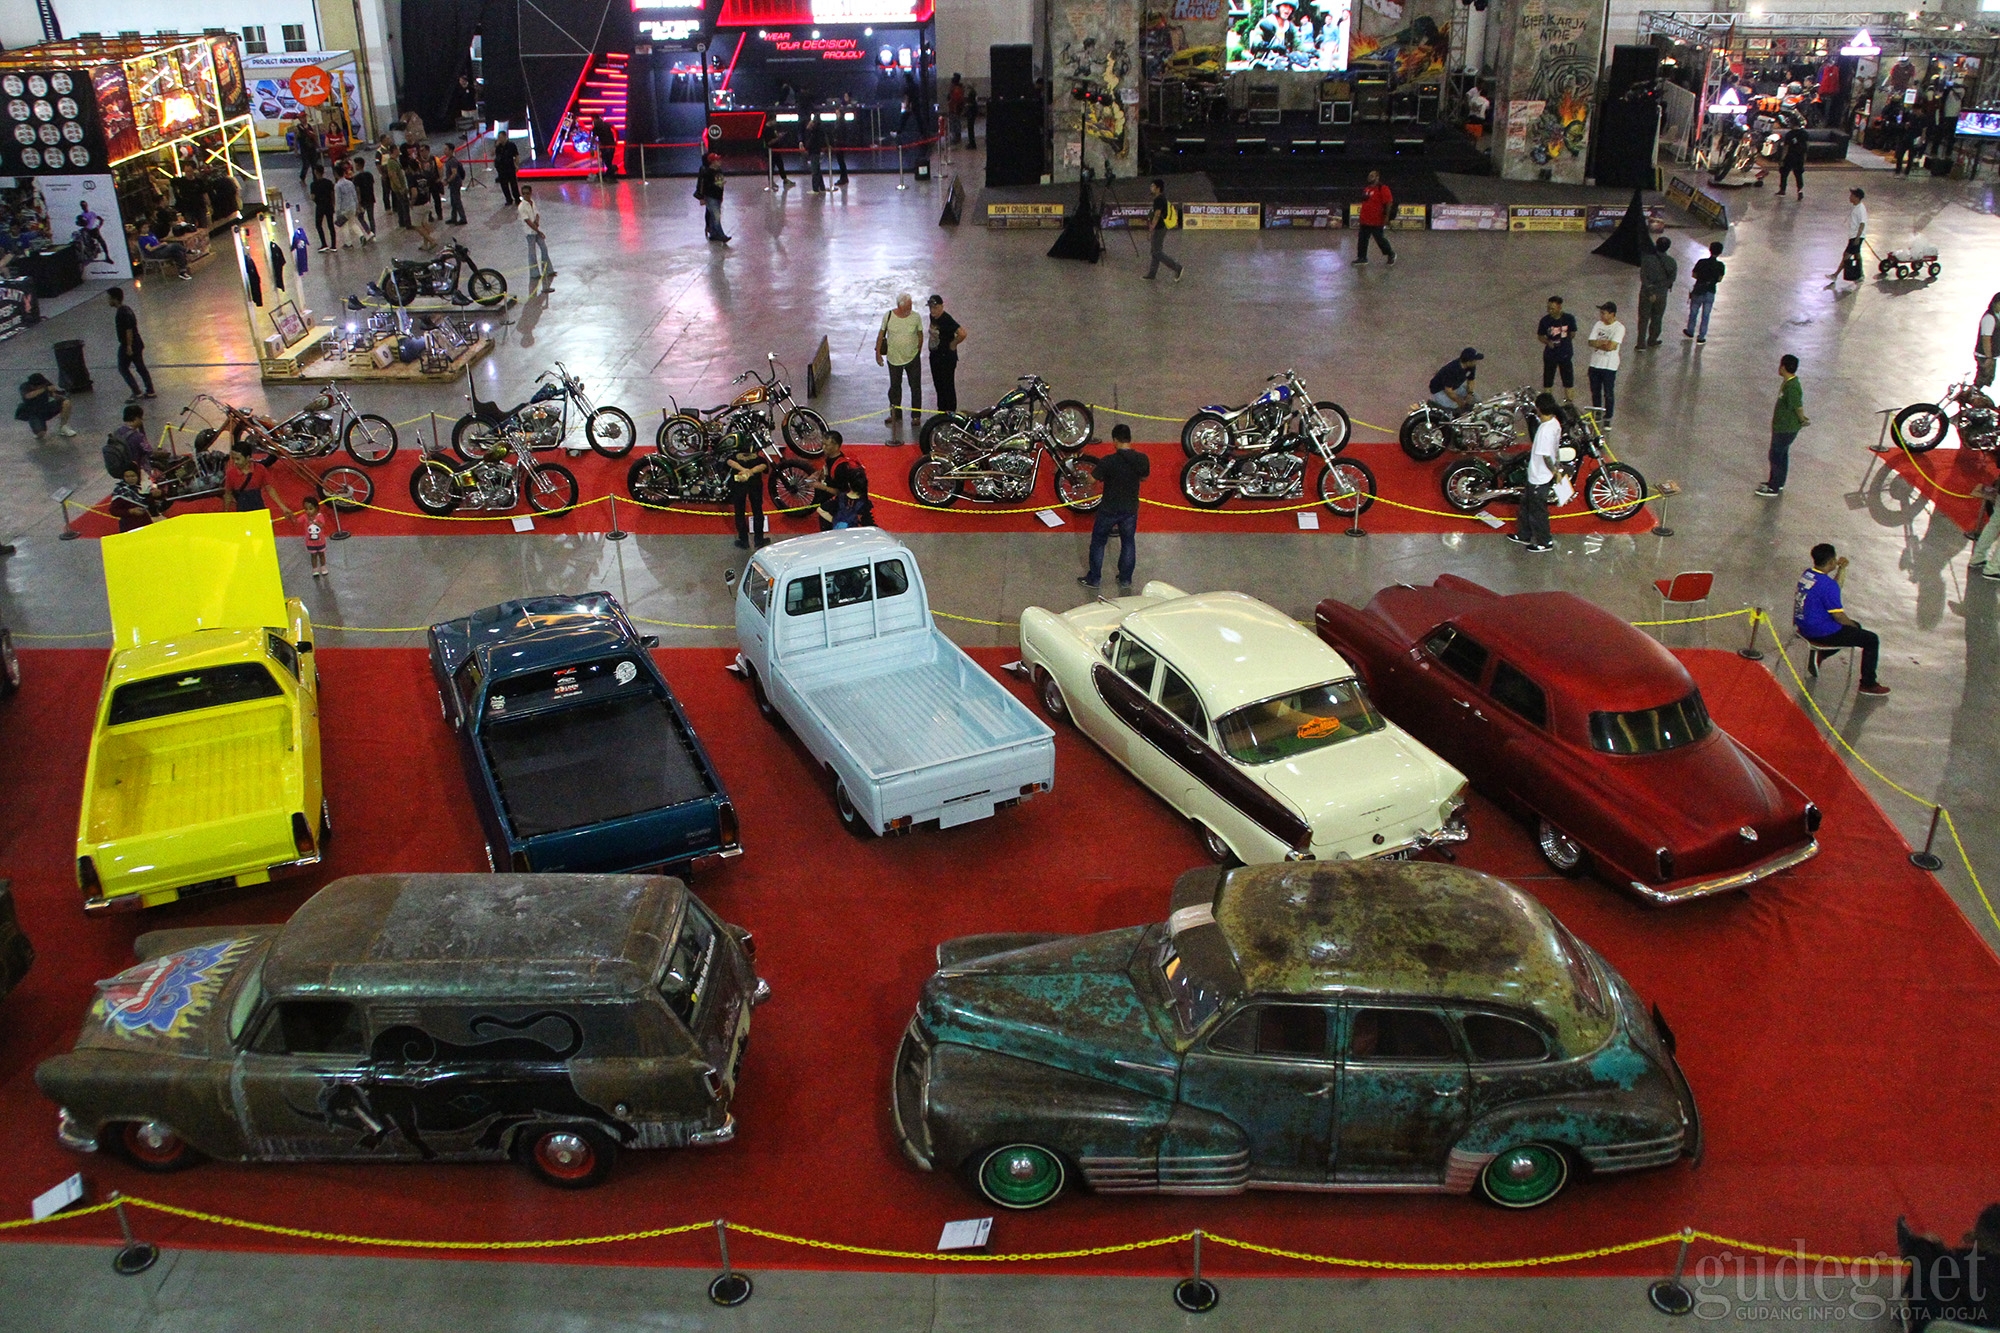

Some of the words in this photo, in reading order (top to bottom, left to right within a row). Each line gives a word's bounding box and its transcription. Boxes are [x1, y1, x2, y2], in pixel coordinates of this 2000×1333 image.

[764, 32, 792, 41] WEAR
[776, 41, 801, 50] YOUR
[801, 39, 857, 50] DECISION
[822, 50, 866, 59] PROUDLY
[1011, 206, 1029, 214] CROSS
[1030, 206, 1040, 214] THE
[1041, 206, 1053, 214] LINE
[1190, 205, 1206, 214] DON'T
[1207, 205, 1225, 214] CROSS
[1226, 206, 1236, 214] THE
[1237, 206, 1249, 214] LINE
[1442, 209, 1480, 217] KUSTOMFEST
[1517, 208, 1533, 216] DON'T
[1534, 208, 1552, 216] CROSS
[1553, 208, 1563, 216] THE
[1563, 208, 1576, 216] LINE
